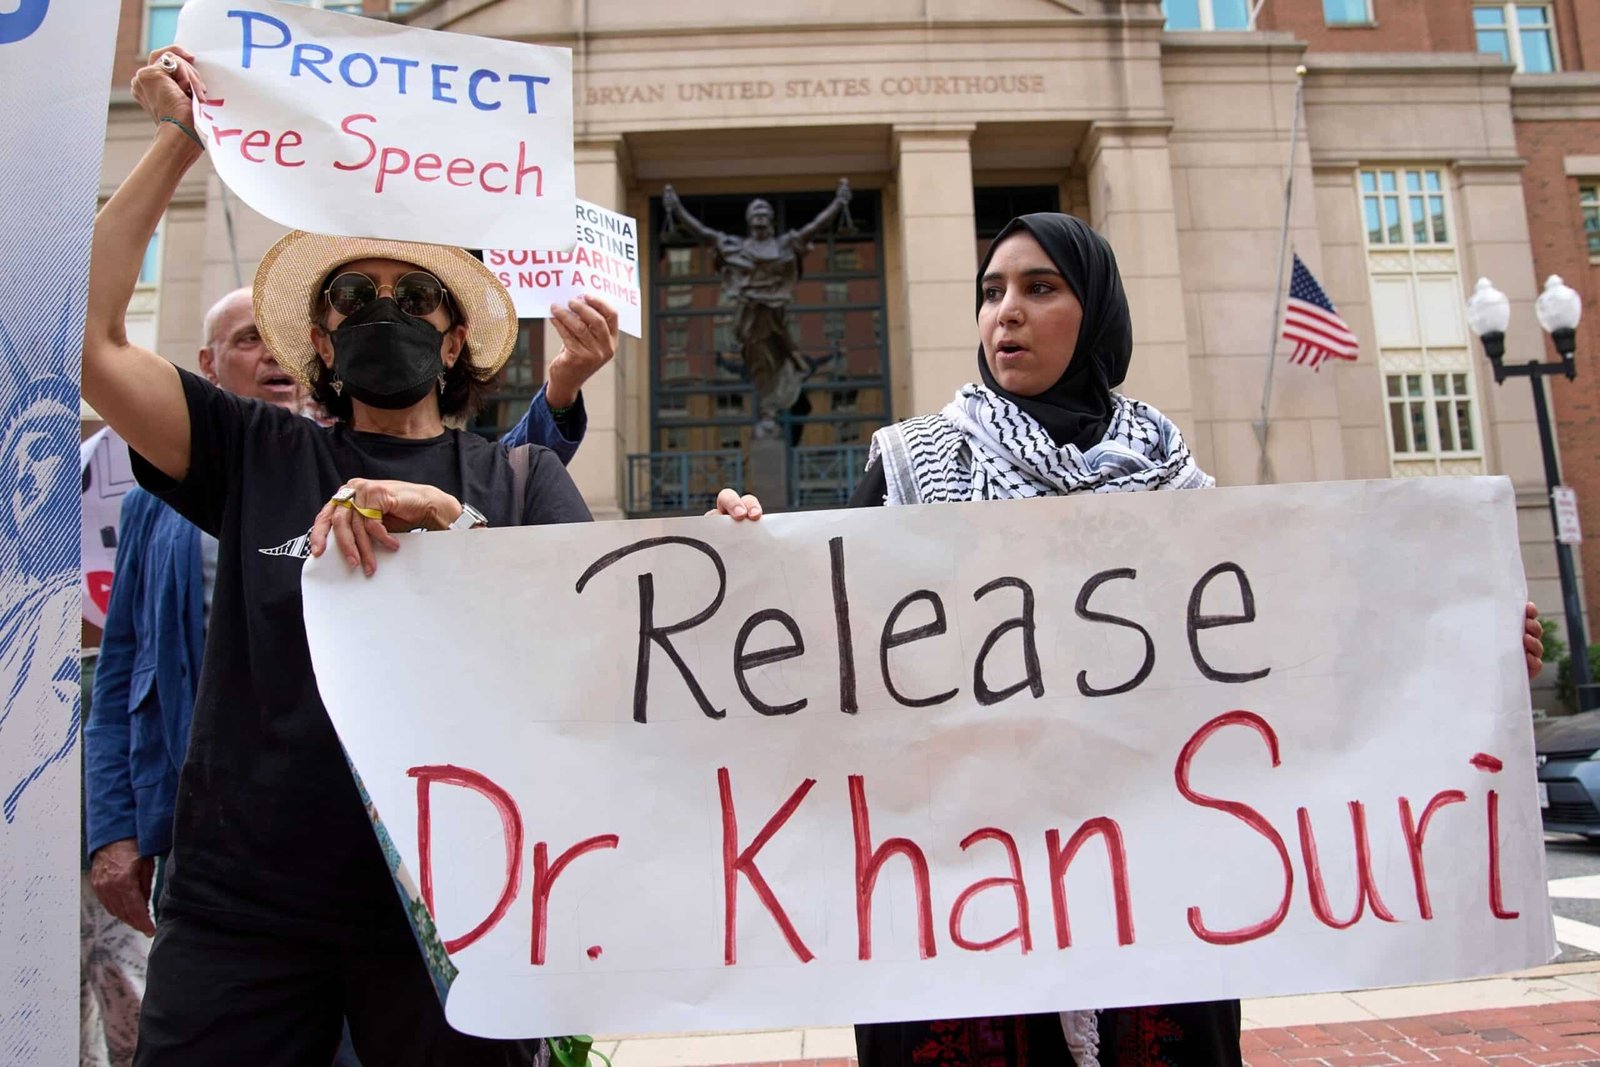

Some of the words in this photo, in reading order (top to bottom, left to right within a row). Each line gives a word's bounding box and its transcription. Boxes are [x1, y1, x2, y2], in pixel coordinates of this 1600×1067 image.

[228, 10, 550, 114] PROTECT
[585, 83, 665, 106] BRYAN
[676, 80, 775, 102] UNITED
[785, 78, 872, 98] STATES
[881, 74, 1046, 97] COURTHOUSE
[334, 114, 543, 197] Speech
[575, 204, 634, 239] RGINIA
[577, 225, 636, 261] ESTINE
[489, 247, 635, 283] SOLIDARITY
[518, 270, 564, 288] NOT
[571, 271, 586, 287] A
[590, 274, 638, 306] CRIME
[576, 536, 1270, 723] Release
[407, 764, 620, 966] Dr.
[717, 767, 1136, 967] Khan
[1173, 710, 1520, 946] Suri
